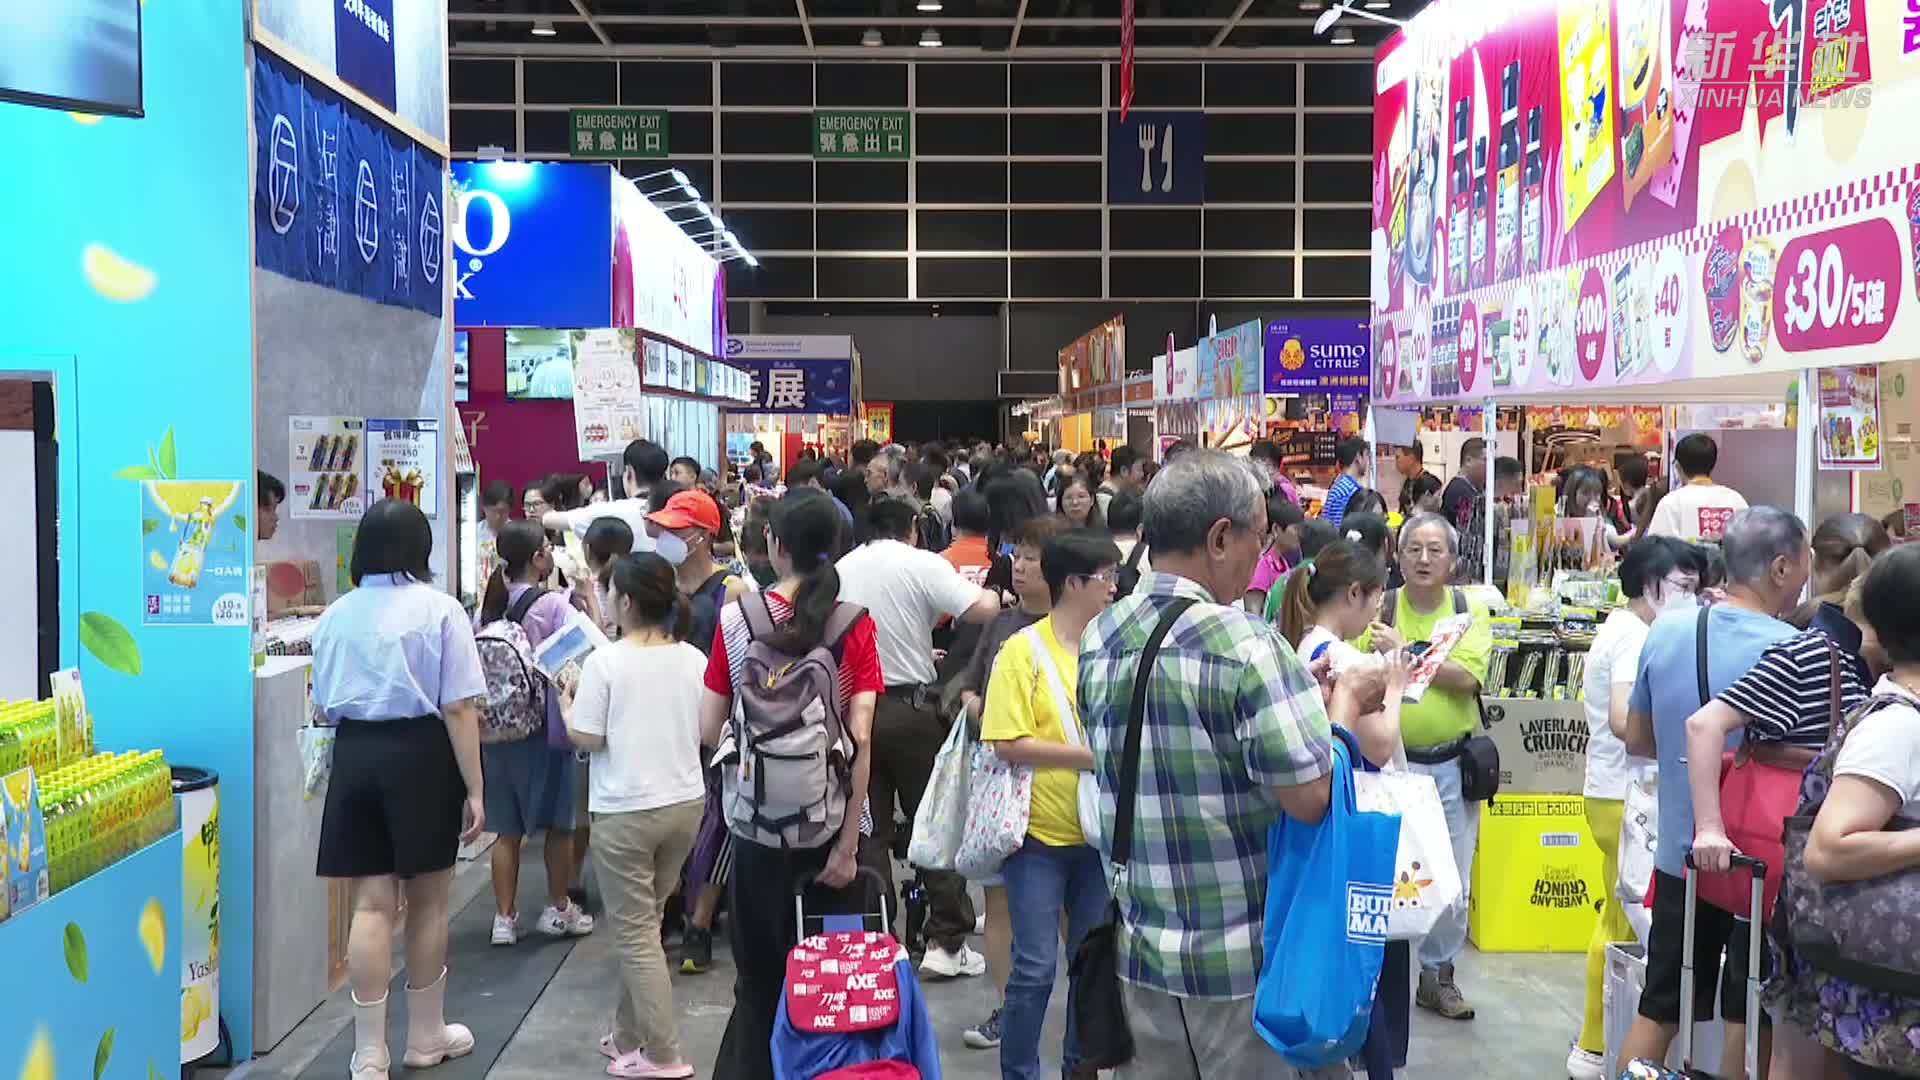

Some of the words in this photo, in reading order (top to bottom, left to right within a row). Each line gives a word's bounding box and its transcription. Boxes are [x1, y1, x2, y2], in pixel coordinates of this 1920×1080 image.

[576, 115, 637, 129] EMERGENCY
[639, 115, 660, 129] EXIT
[820, 116, 880, 130] EMERGENCY
[882, 117, 904, 130] EXIT
[576, 131, 660, 152] 緊急出口
[820, 132, 903, 153] 緊急出口
[1314, 358, 1361, 370] CITRUS
[1522, 733, 1590, 755] CRUNCH
[1534, 879, 1586, 897] CRUNCH
[1530, 892, 1590, 909] LAVERLAND
[799, 934, 829, 951] AXE
[846, 972, 880, 991] AXE
[873, 987, 896, 1001] AXE
[813, 1014, 837, 1028] AXE
